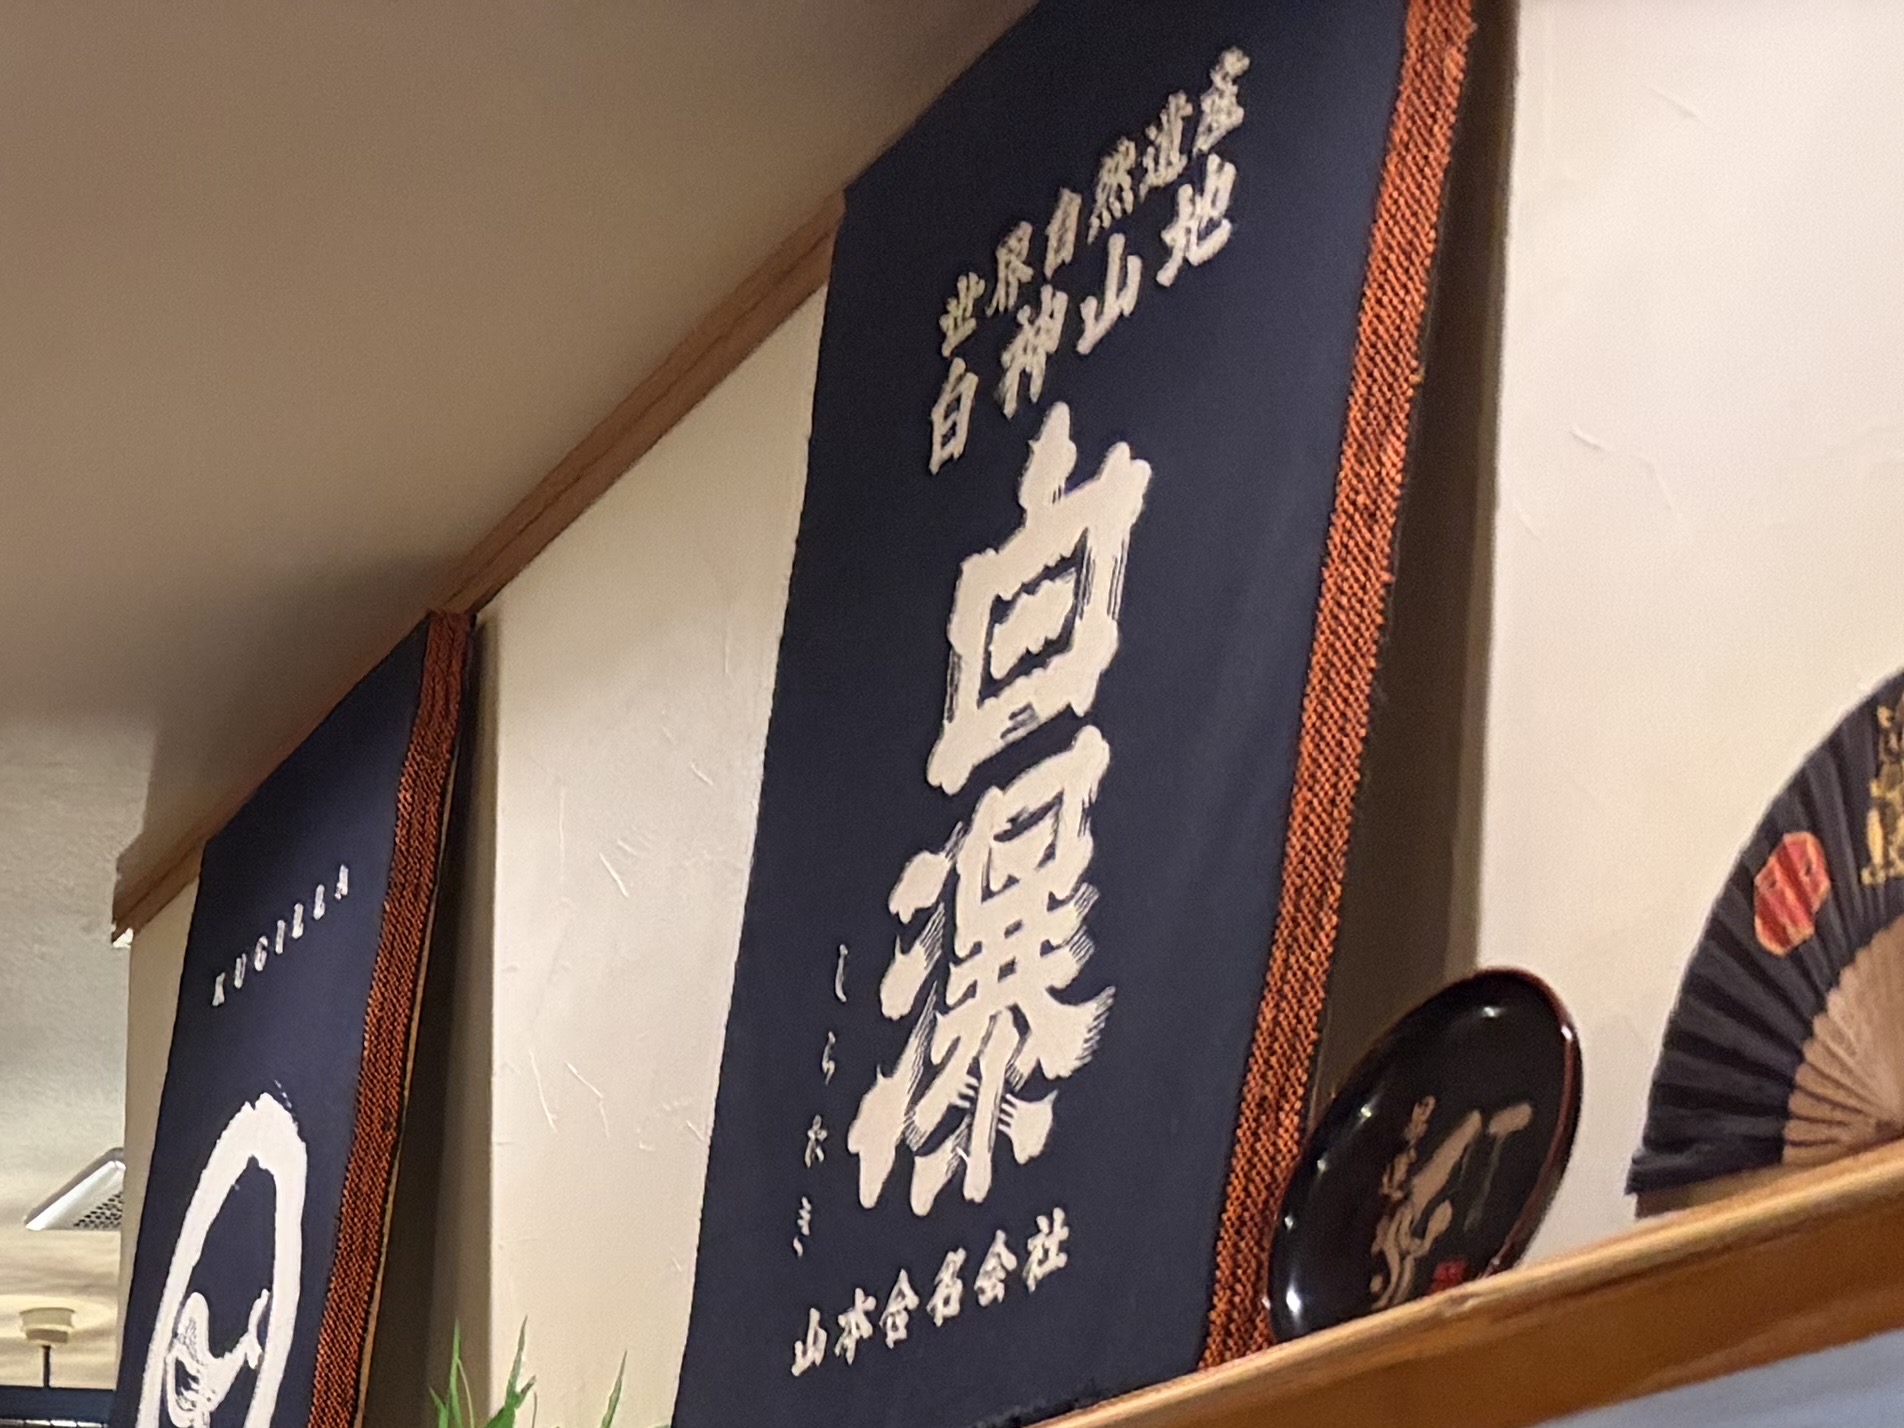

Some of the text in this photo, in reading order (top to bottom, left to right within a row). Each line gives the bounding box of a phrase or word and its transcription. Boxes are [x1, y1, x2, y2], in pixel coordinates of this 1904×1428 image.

[928, 153, 1239, 473] 白神山地
[940, 45, 1251, 359] 世界自然遺産
[792, 1205, 1072, 1379] 山本合名会社
